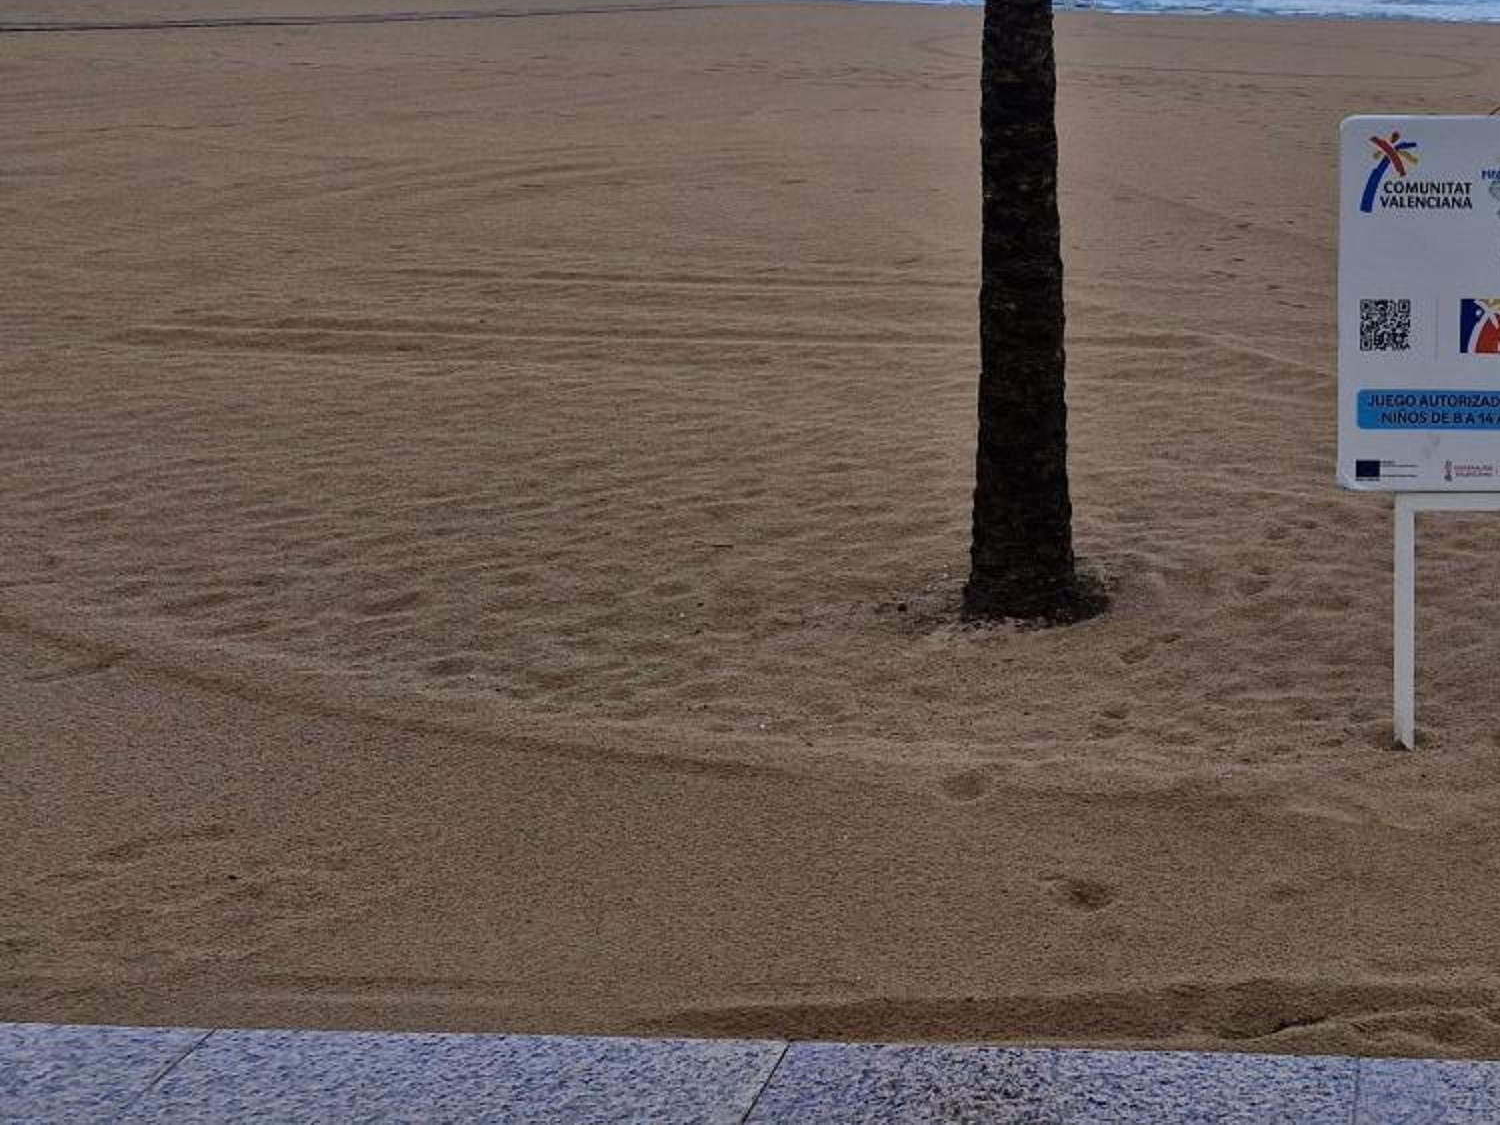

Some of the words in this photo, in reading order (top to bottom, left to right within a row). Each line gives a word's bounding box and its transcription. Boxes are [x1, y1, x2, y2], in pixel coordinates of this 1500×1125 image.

[1383, 181, 1472, 194] COMUNITAT
[1380, 196, 1472, 208] VALENCIANA
[1368, 394, 1416, 407] JUEGO
[1381, 408, 1427, 423] NIÑOS
[1431, 411, 1449, 423] DE
[1465, 412, 1475, 424] A
